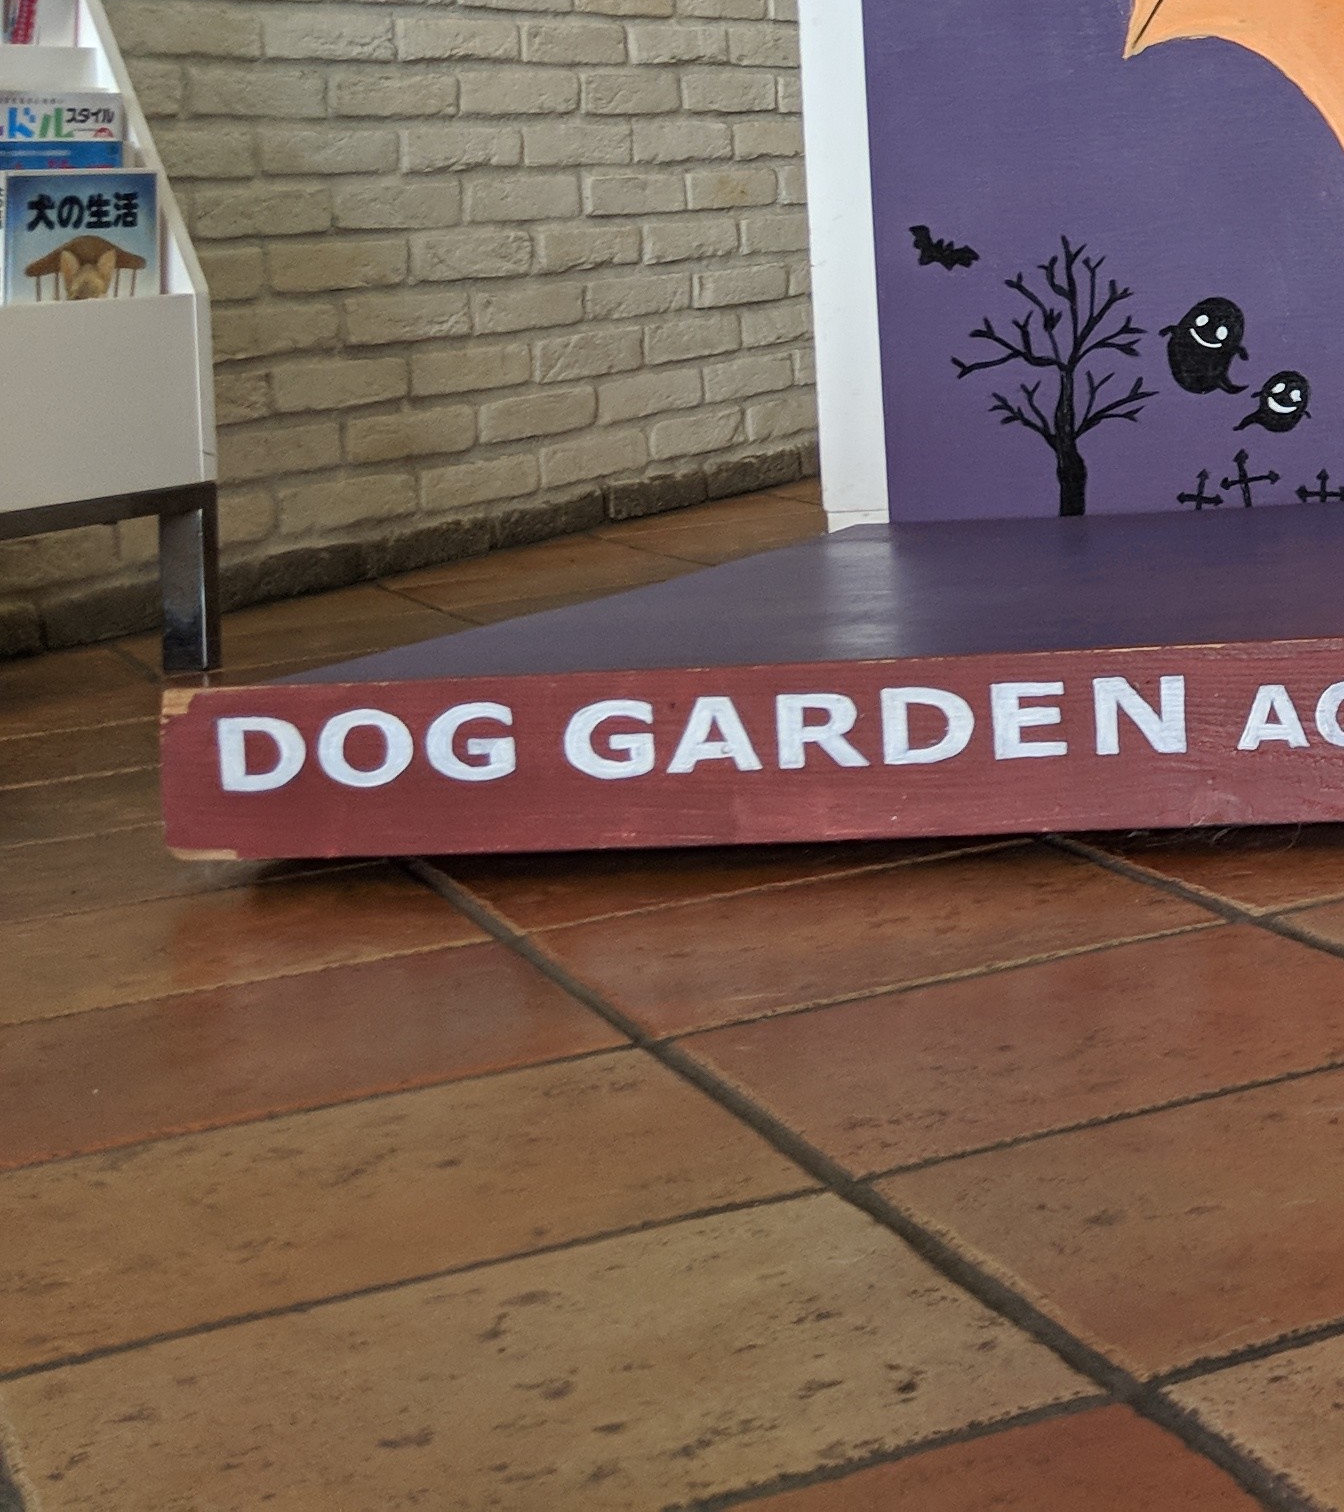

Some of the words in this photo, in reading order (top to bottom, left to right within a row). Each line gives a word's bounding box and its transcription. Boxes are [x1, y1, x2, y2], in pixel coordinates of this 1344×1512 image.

[65, 107, 115, 124] スタイル
[27, 190, 140, 232] 犬の生活
[214, 699, 518, 794] DOG
[561, 673, 1190, 781] GARDEN
